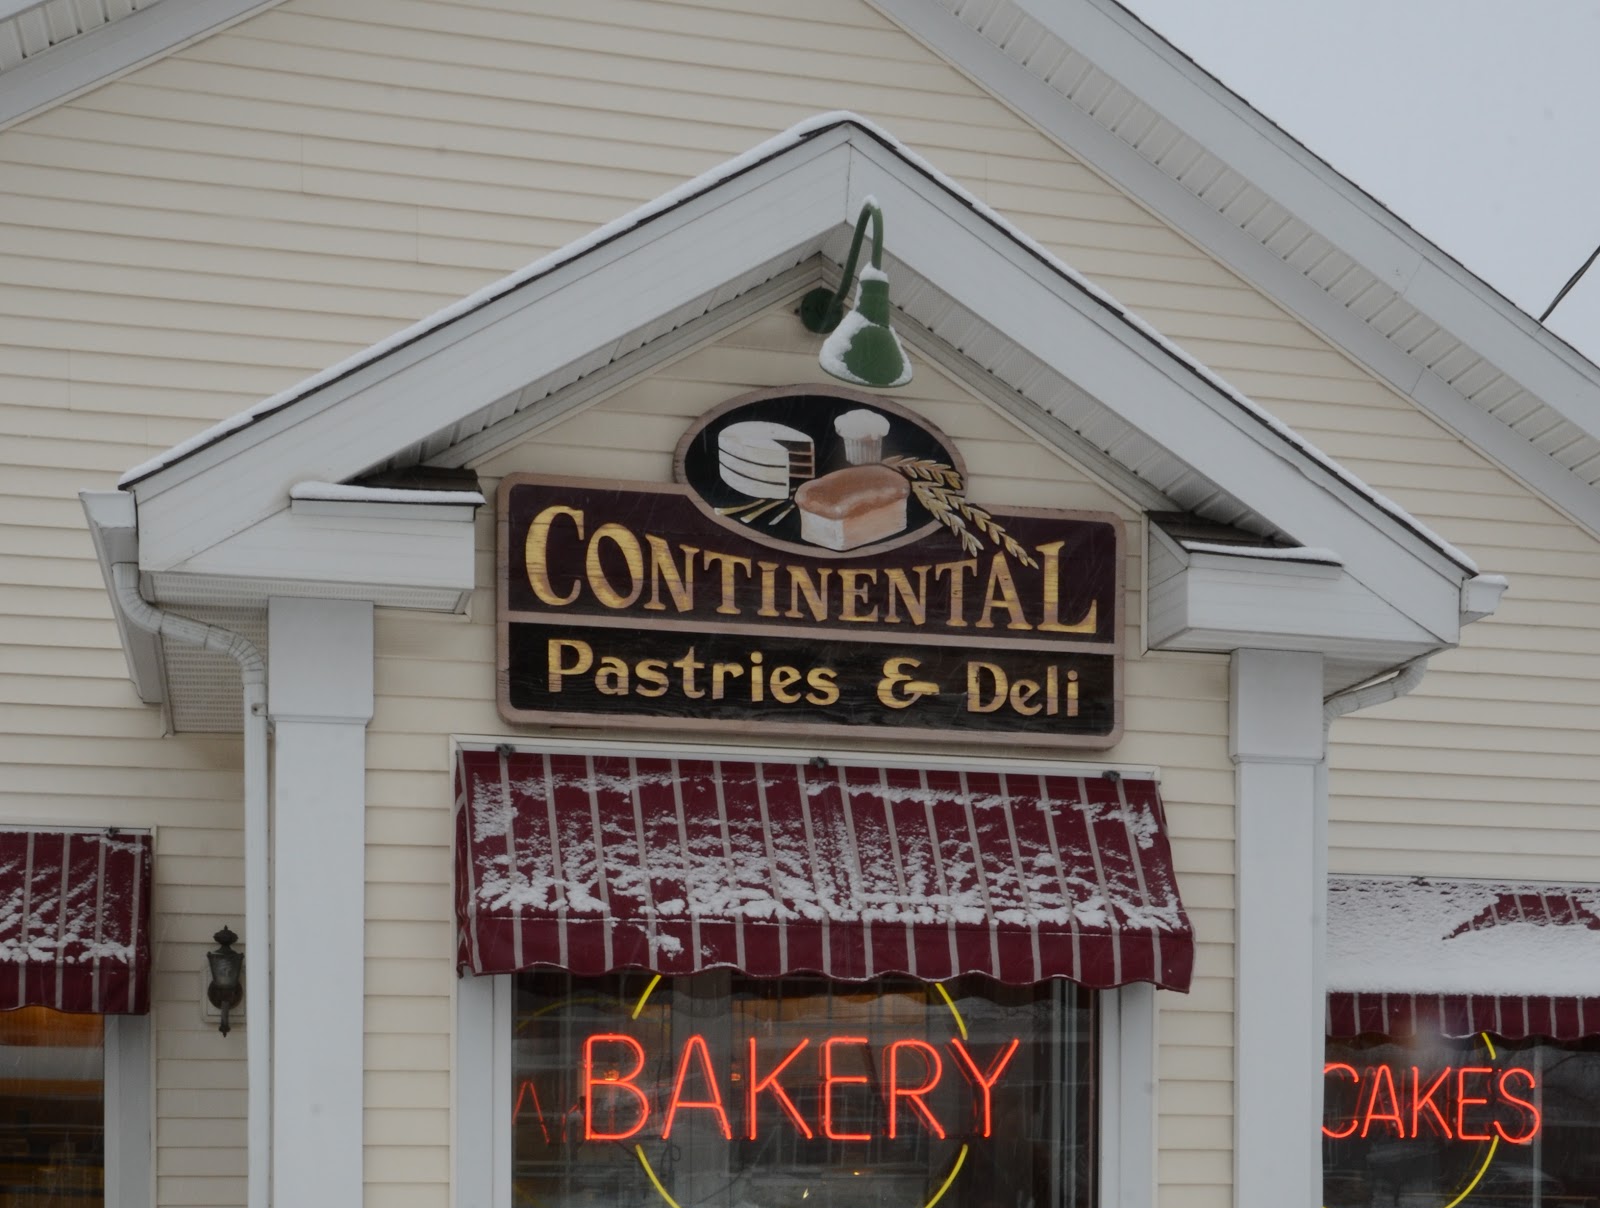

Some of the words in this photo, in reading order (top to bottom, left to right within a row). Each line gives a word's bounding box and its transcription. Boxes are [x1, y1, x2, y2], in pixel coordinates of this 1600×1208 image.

[525, 505, 1097, 634] CONTINENTAL
[547, 639, 840, 706] Pastries
[877, 658, 939, 709] &
[967, 662, 1079, 718] Deli
[585, 1034, 1020, 1141] BAKERY
[1322, 1062, 1541, 1143] CAKES
